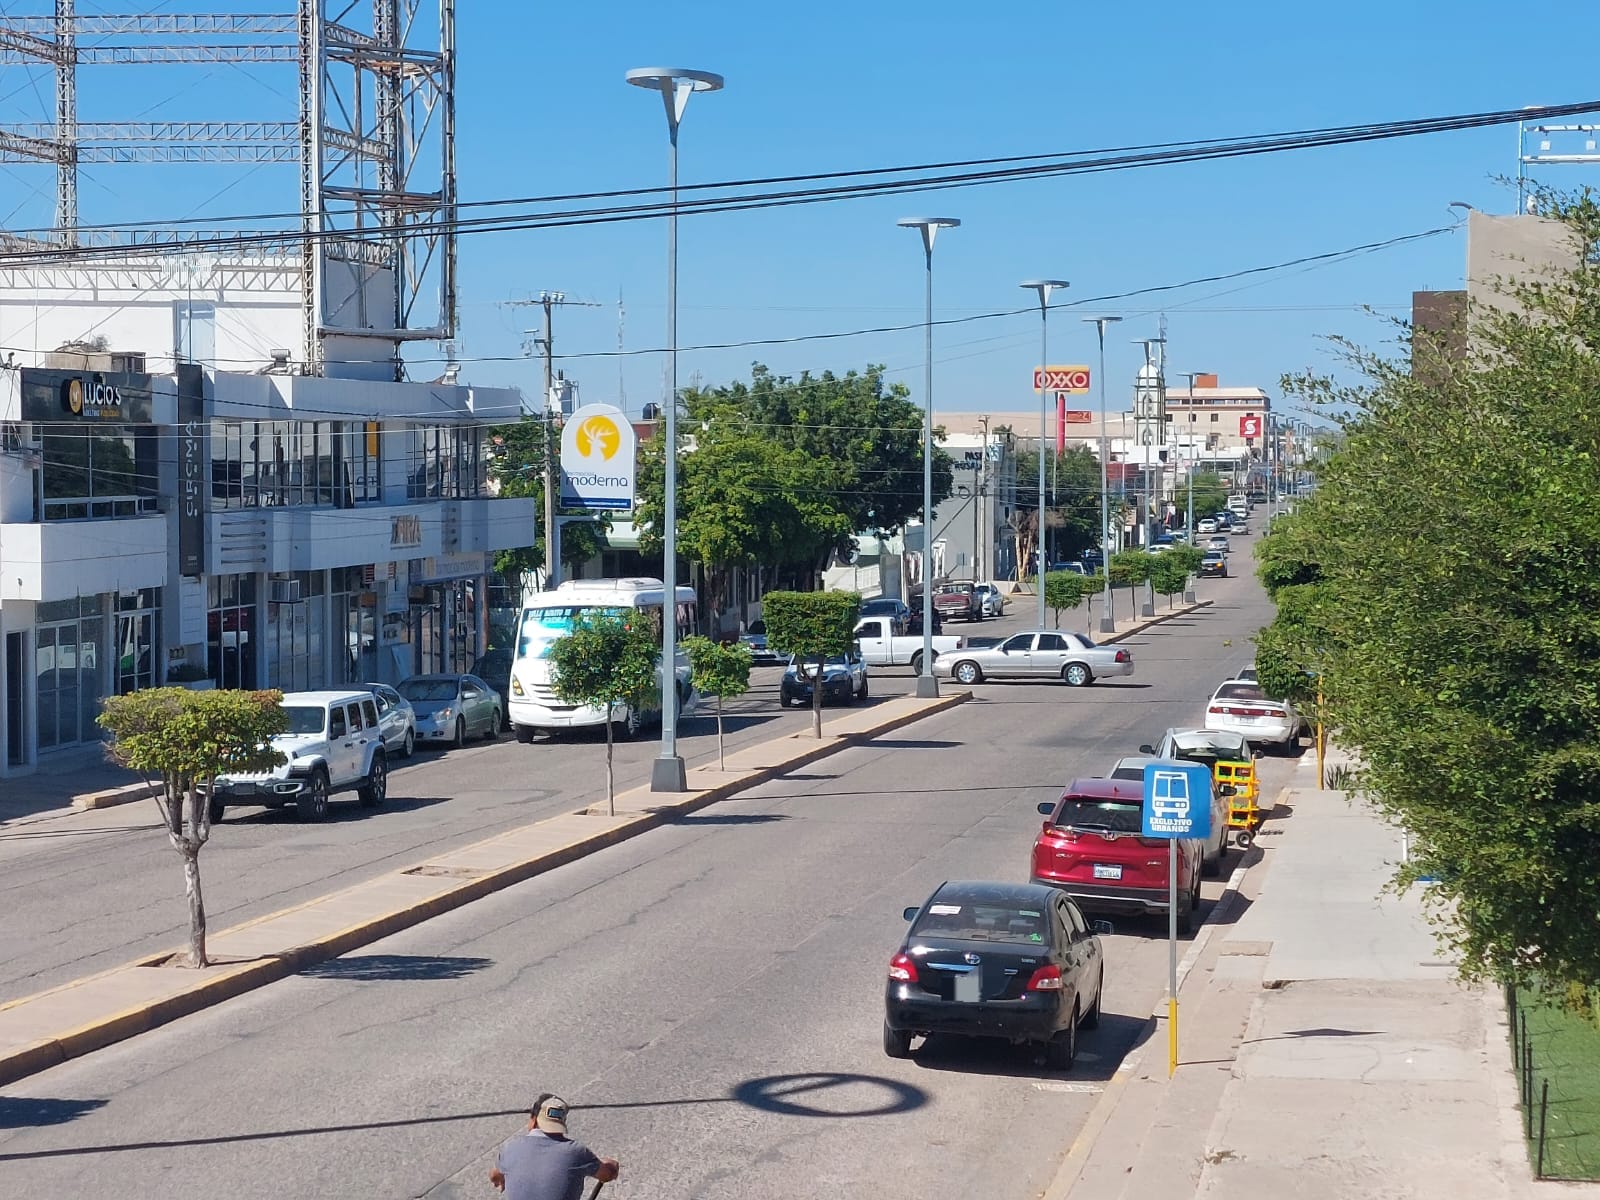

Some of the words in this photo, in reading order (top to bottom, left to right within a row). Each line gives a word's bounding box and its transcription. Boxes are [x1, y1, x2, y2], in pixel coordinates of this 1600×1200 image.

[1036, 371, 1088, 388] OXXO
[84, 382, 121, 406] LUCIO'S
[566, 474, 628, 487] moderna
